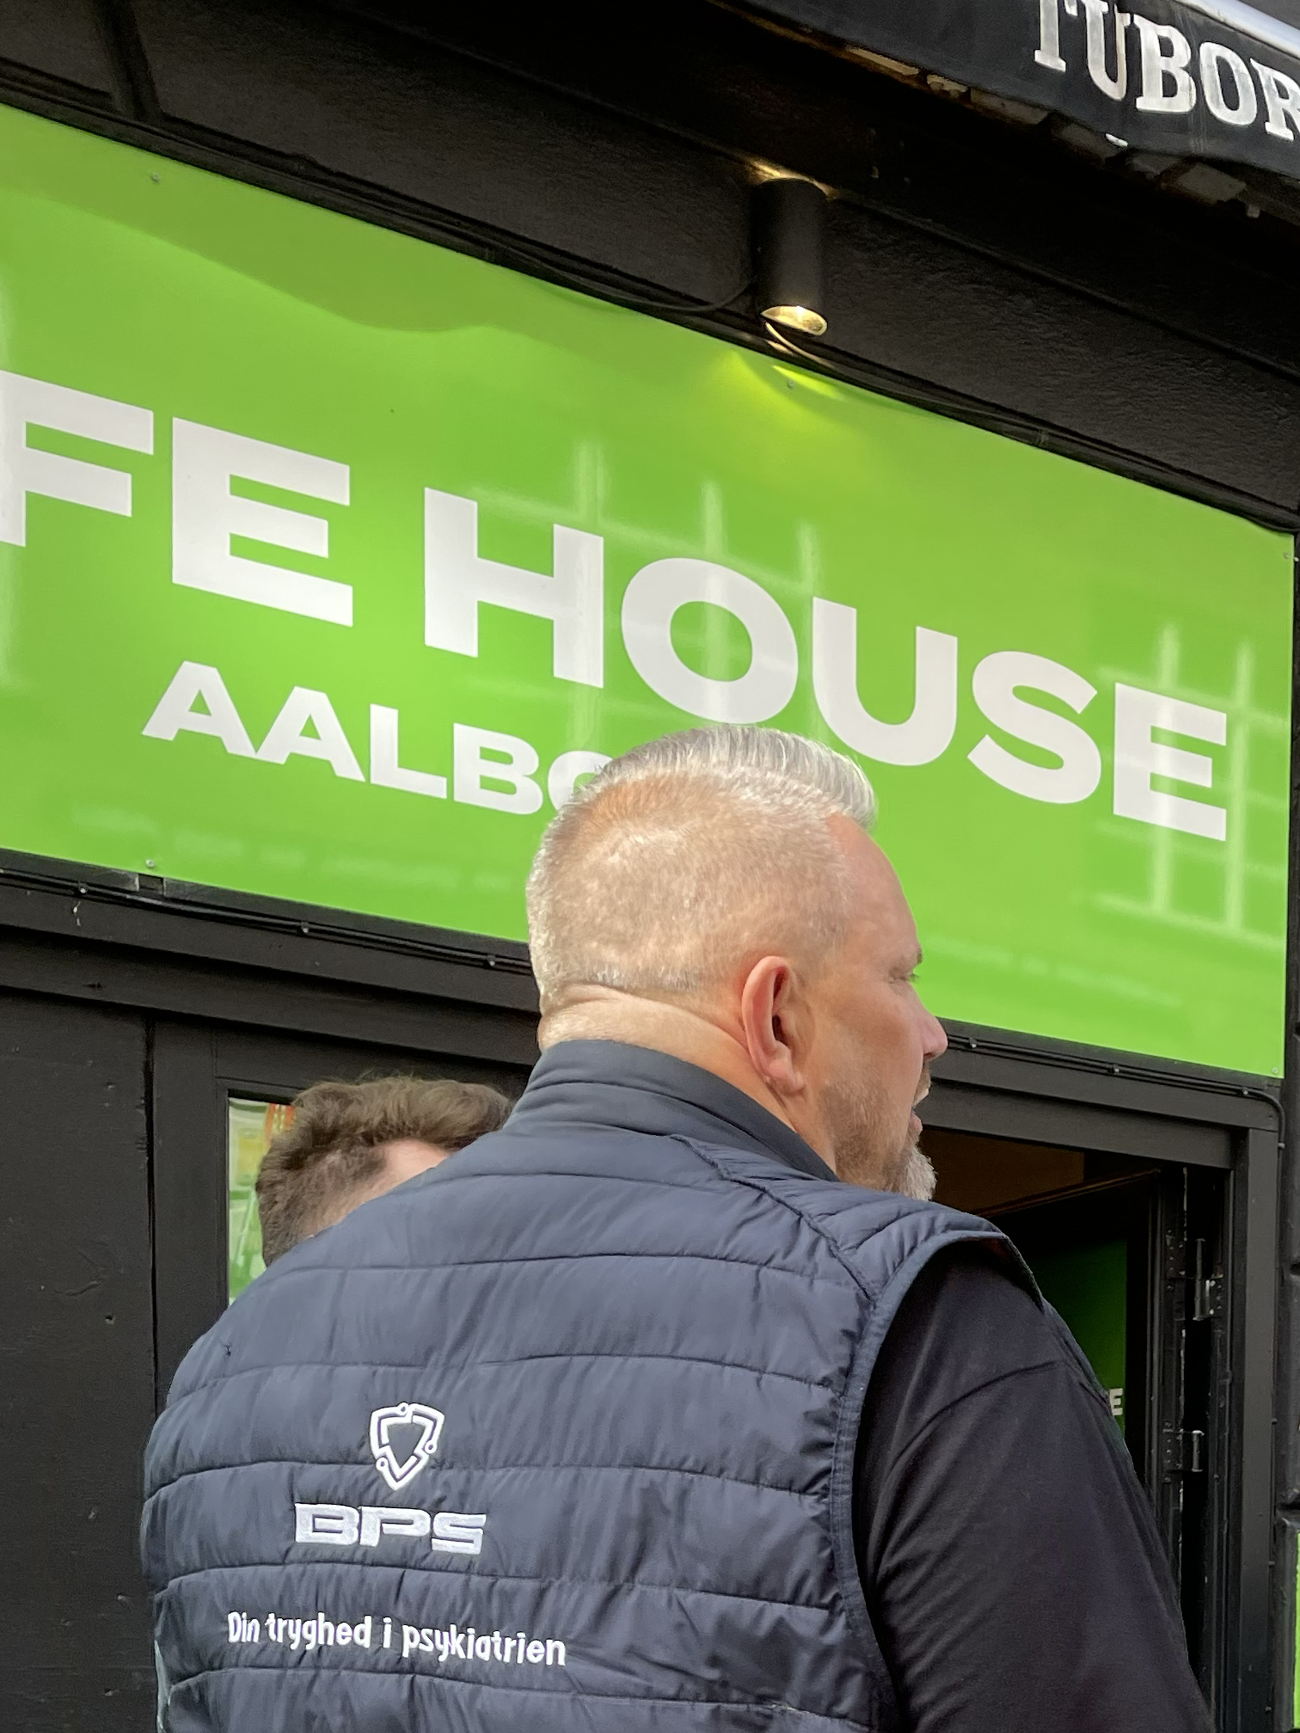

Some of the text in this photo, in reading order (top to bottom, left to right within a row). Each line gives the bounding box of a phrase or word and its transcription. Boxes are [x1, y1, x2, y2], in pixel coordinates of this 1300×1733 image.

[424, 487, 1227, 841] HOUSE
[294, 1502, 487, 1555] BPS
[228, 1611, 566, 1666] Din tryghed i psykiatrien
